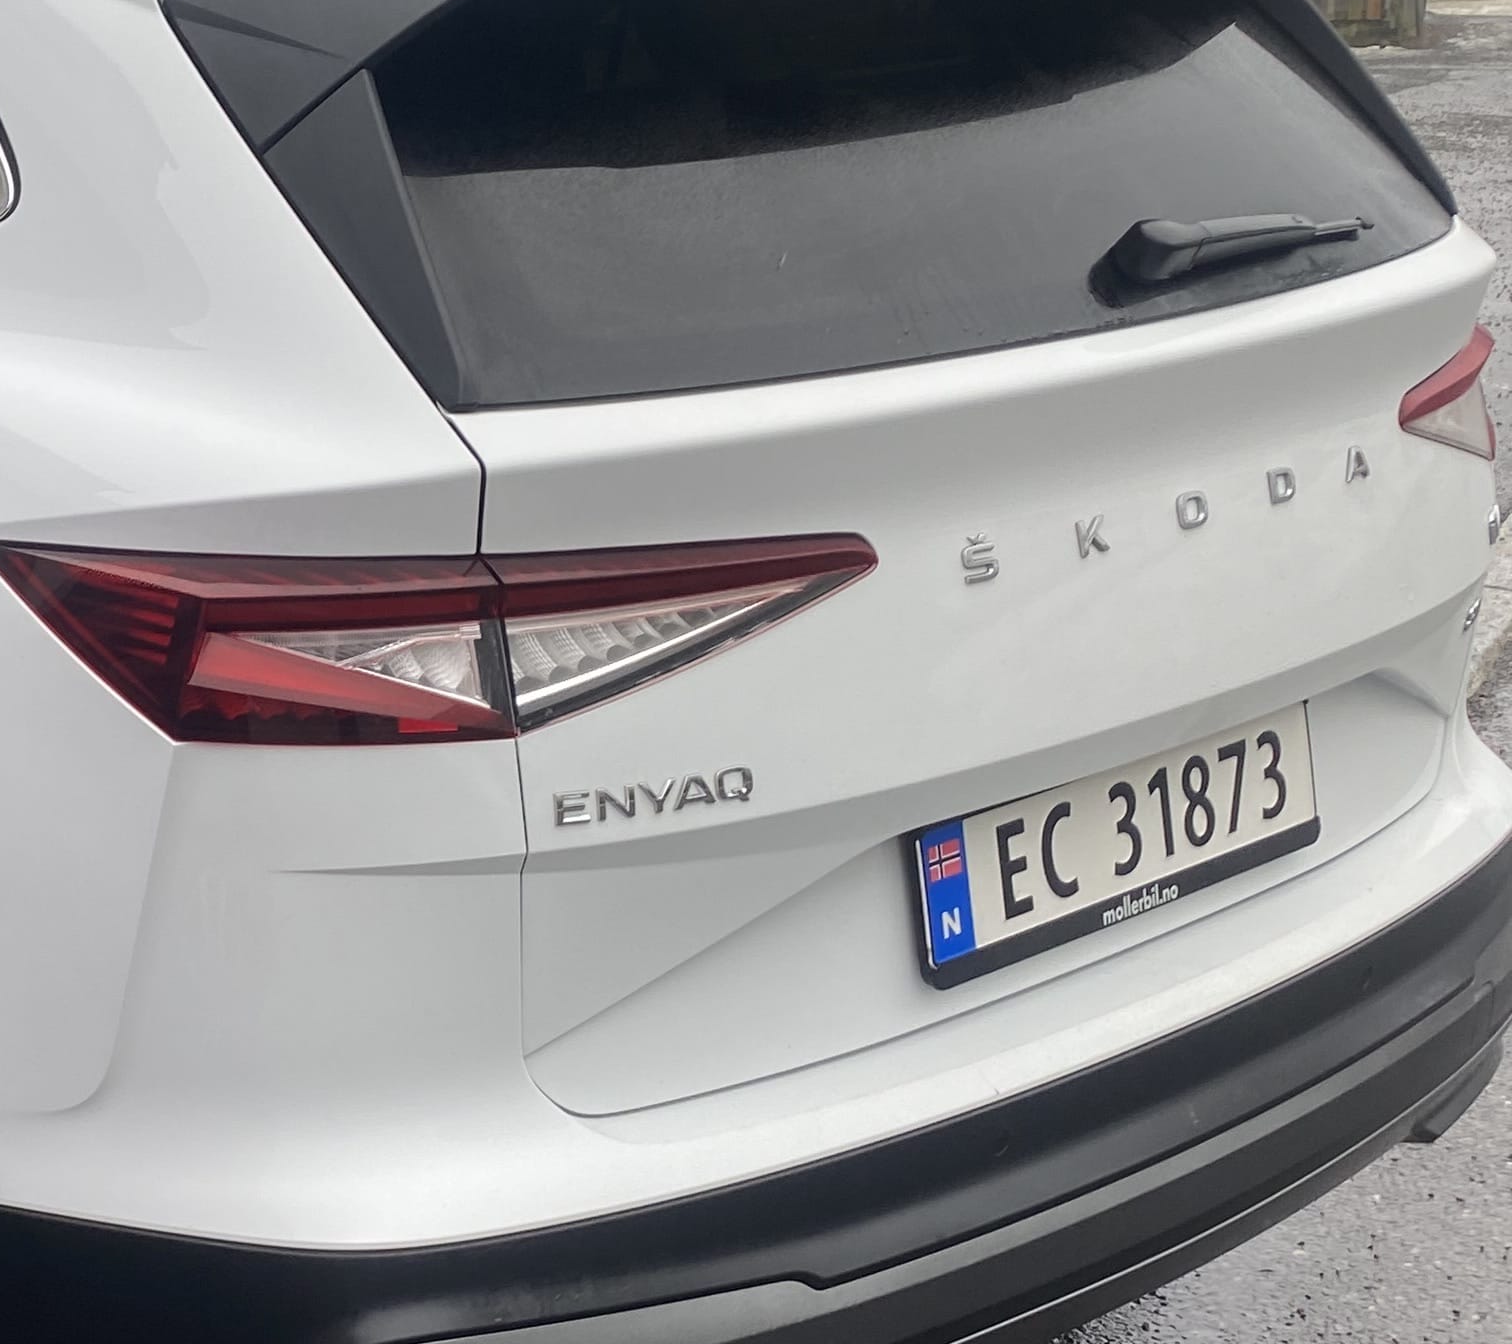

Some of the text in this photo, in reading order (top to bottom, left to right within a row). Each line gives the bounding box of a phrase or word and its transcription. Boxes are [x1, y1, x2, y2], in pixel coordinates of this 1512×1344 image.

[960, 443, 1372, 587] ŠKODA
[553, 763, 755, 828] ENYAQ
[995, 728, 1289, 922] EC 31873
[941, 907, 964, 943] N
[1102, 882, 1180, 927] mollerbil.no
